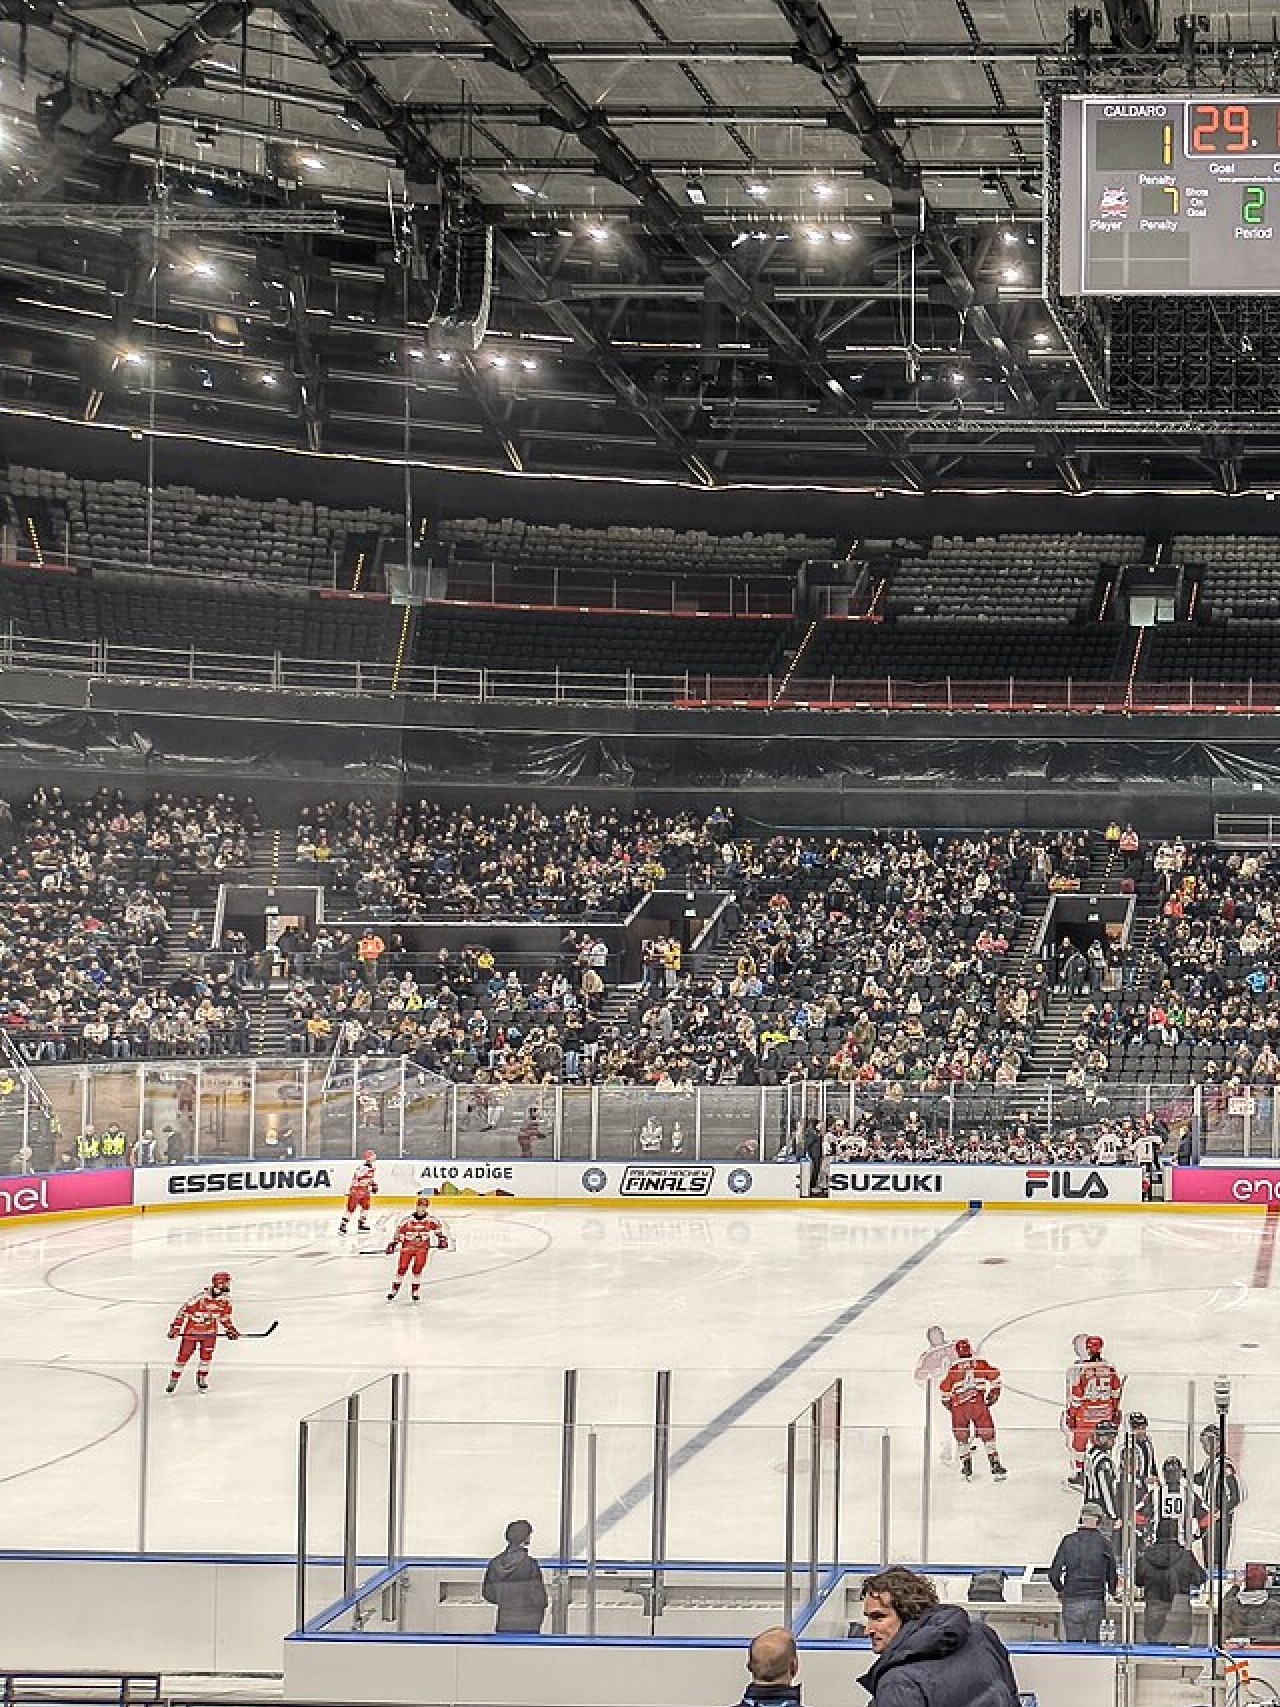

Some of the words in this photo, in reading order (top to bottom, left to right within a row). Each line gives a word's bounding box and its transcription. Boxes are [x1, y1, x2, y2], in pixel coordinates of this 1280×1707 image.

[1104, 105, 1167, 117] CALDARO
[1163, 125, 1172, 165] 1
[1209, 163, 1235, 174] Goal
[1139, 174, 1176, 187] Penalty
[1163, 187, 1180, 215] 7
[1241, 186, 1265, 224] 2
[1089, 219, 1123, 232] Player
[1140, 219, 1178, 231] Penalty
[1235, 228, 1273, 240] Period
[167, 1169, 332, 1194] ESSELUNGA
[625, 1177, 707, 1191] FINALS
[830, 1173, 943, 1193] SUZUKI
[1025, 1170, 1109, 1199] FILA
[1165, 1498, 1183, 1515] 50
